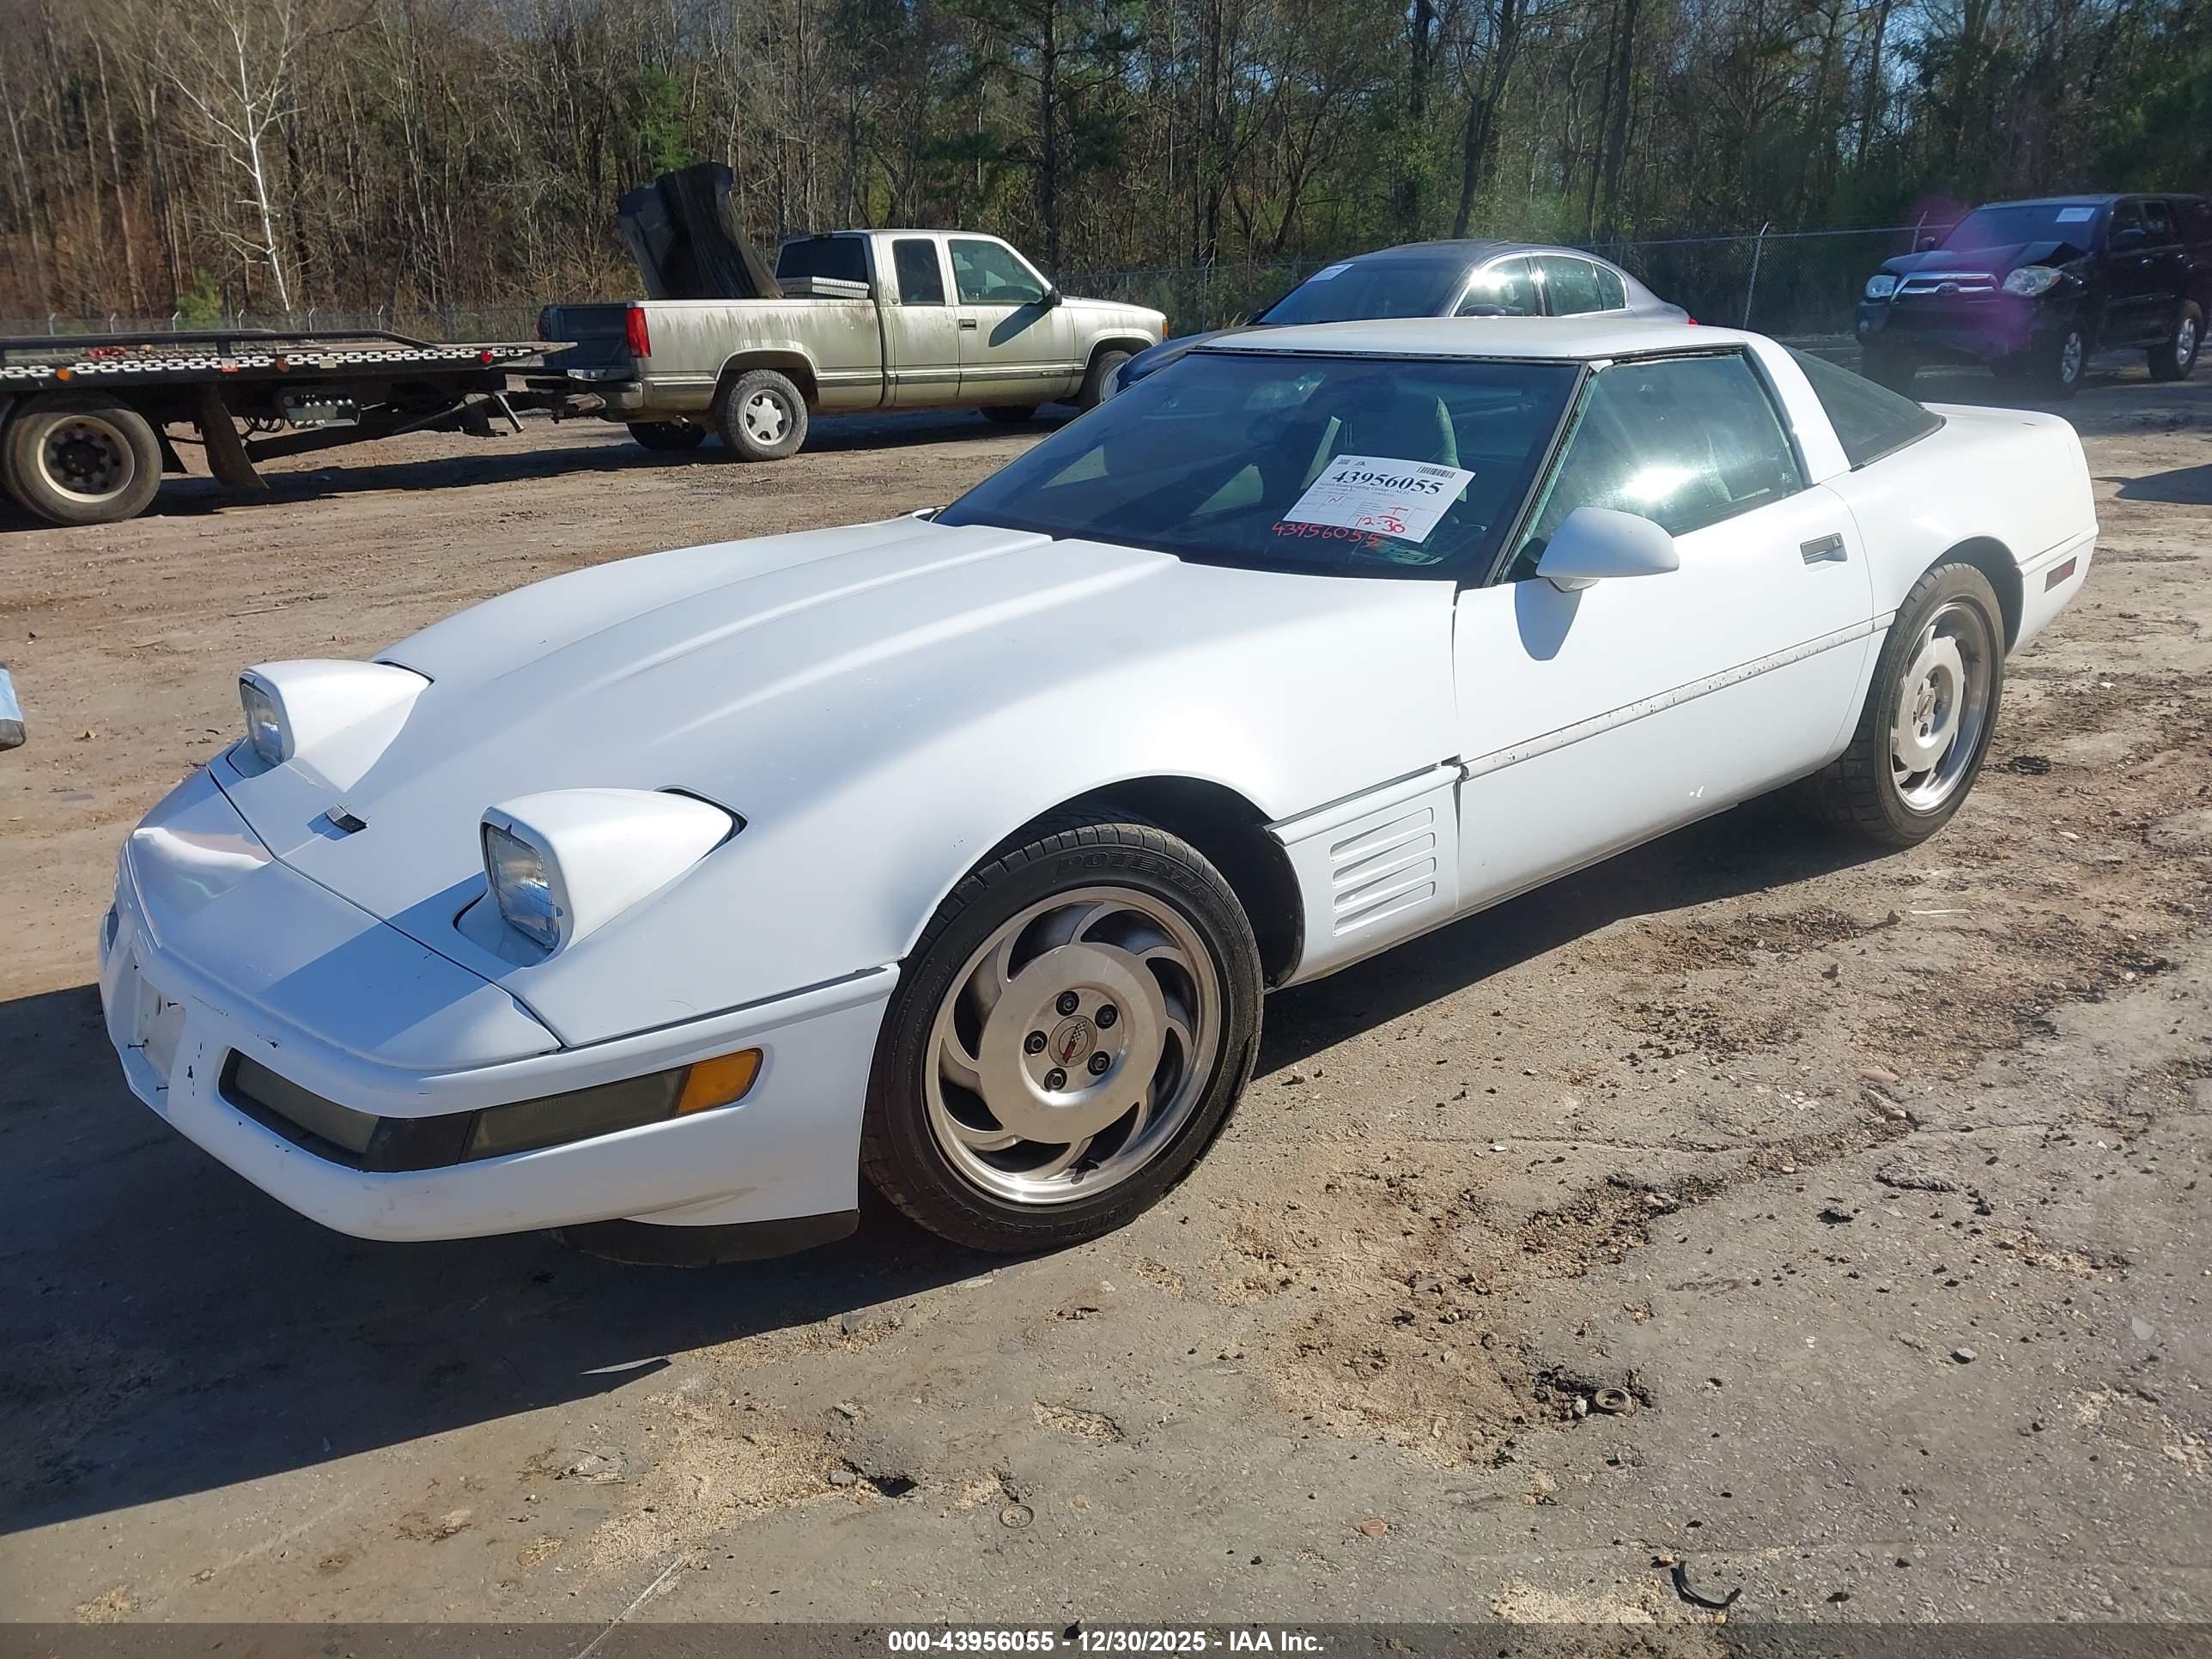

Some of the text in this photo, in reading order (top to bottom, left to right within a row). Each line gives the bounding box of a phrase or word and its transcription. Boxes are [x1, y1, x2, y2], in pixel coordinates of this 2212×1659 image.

[1332, 470, 1445, 495] 43956055
[1272, 521, 1390, 547] 43956055
[1057, 851, 1209, 902] POTENZA
